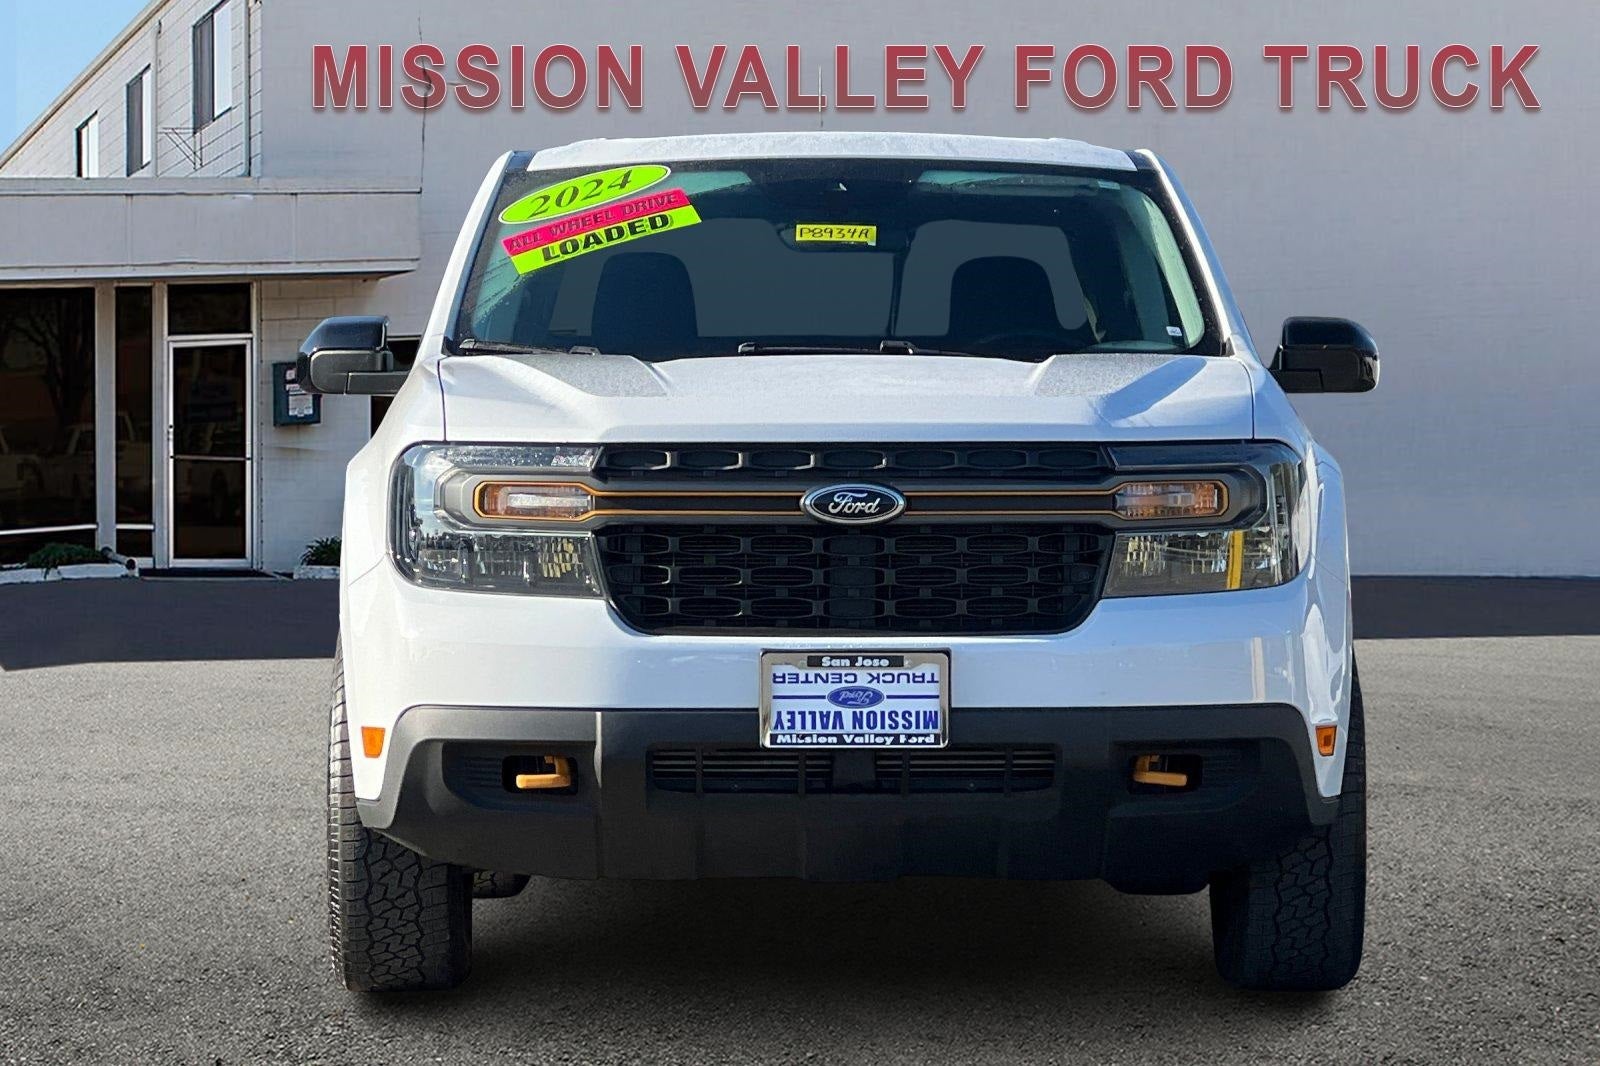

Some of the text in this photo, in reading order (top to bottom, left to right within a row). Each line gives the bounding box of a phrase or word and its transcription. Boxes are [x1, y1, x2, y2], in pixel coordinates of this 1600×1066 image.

[312, 43, 1541, 109] MISSION VALLEY FORD TRUCK
[527, 169, 632, 218] 2024
[508, 192, 680, 252] ALL WHEEL DRIVE
[541, 213, 674, 263] LOADED
[800, 227, 869, 238] P8934A
[828, 491, 881, 514] Ford
[821, 656, 890, 667] San Jose
[772, 672, 939, 684] TRUCK CENTER
[838, 691, 874, 705] Ford
[774, 710, 938, 730] MISSION VALLEY
[844, 733, 895, 746] Valley
